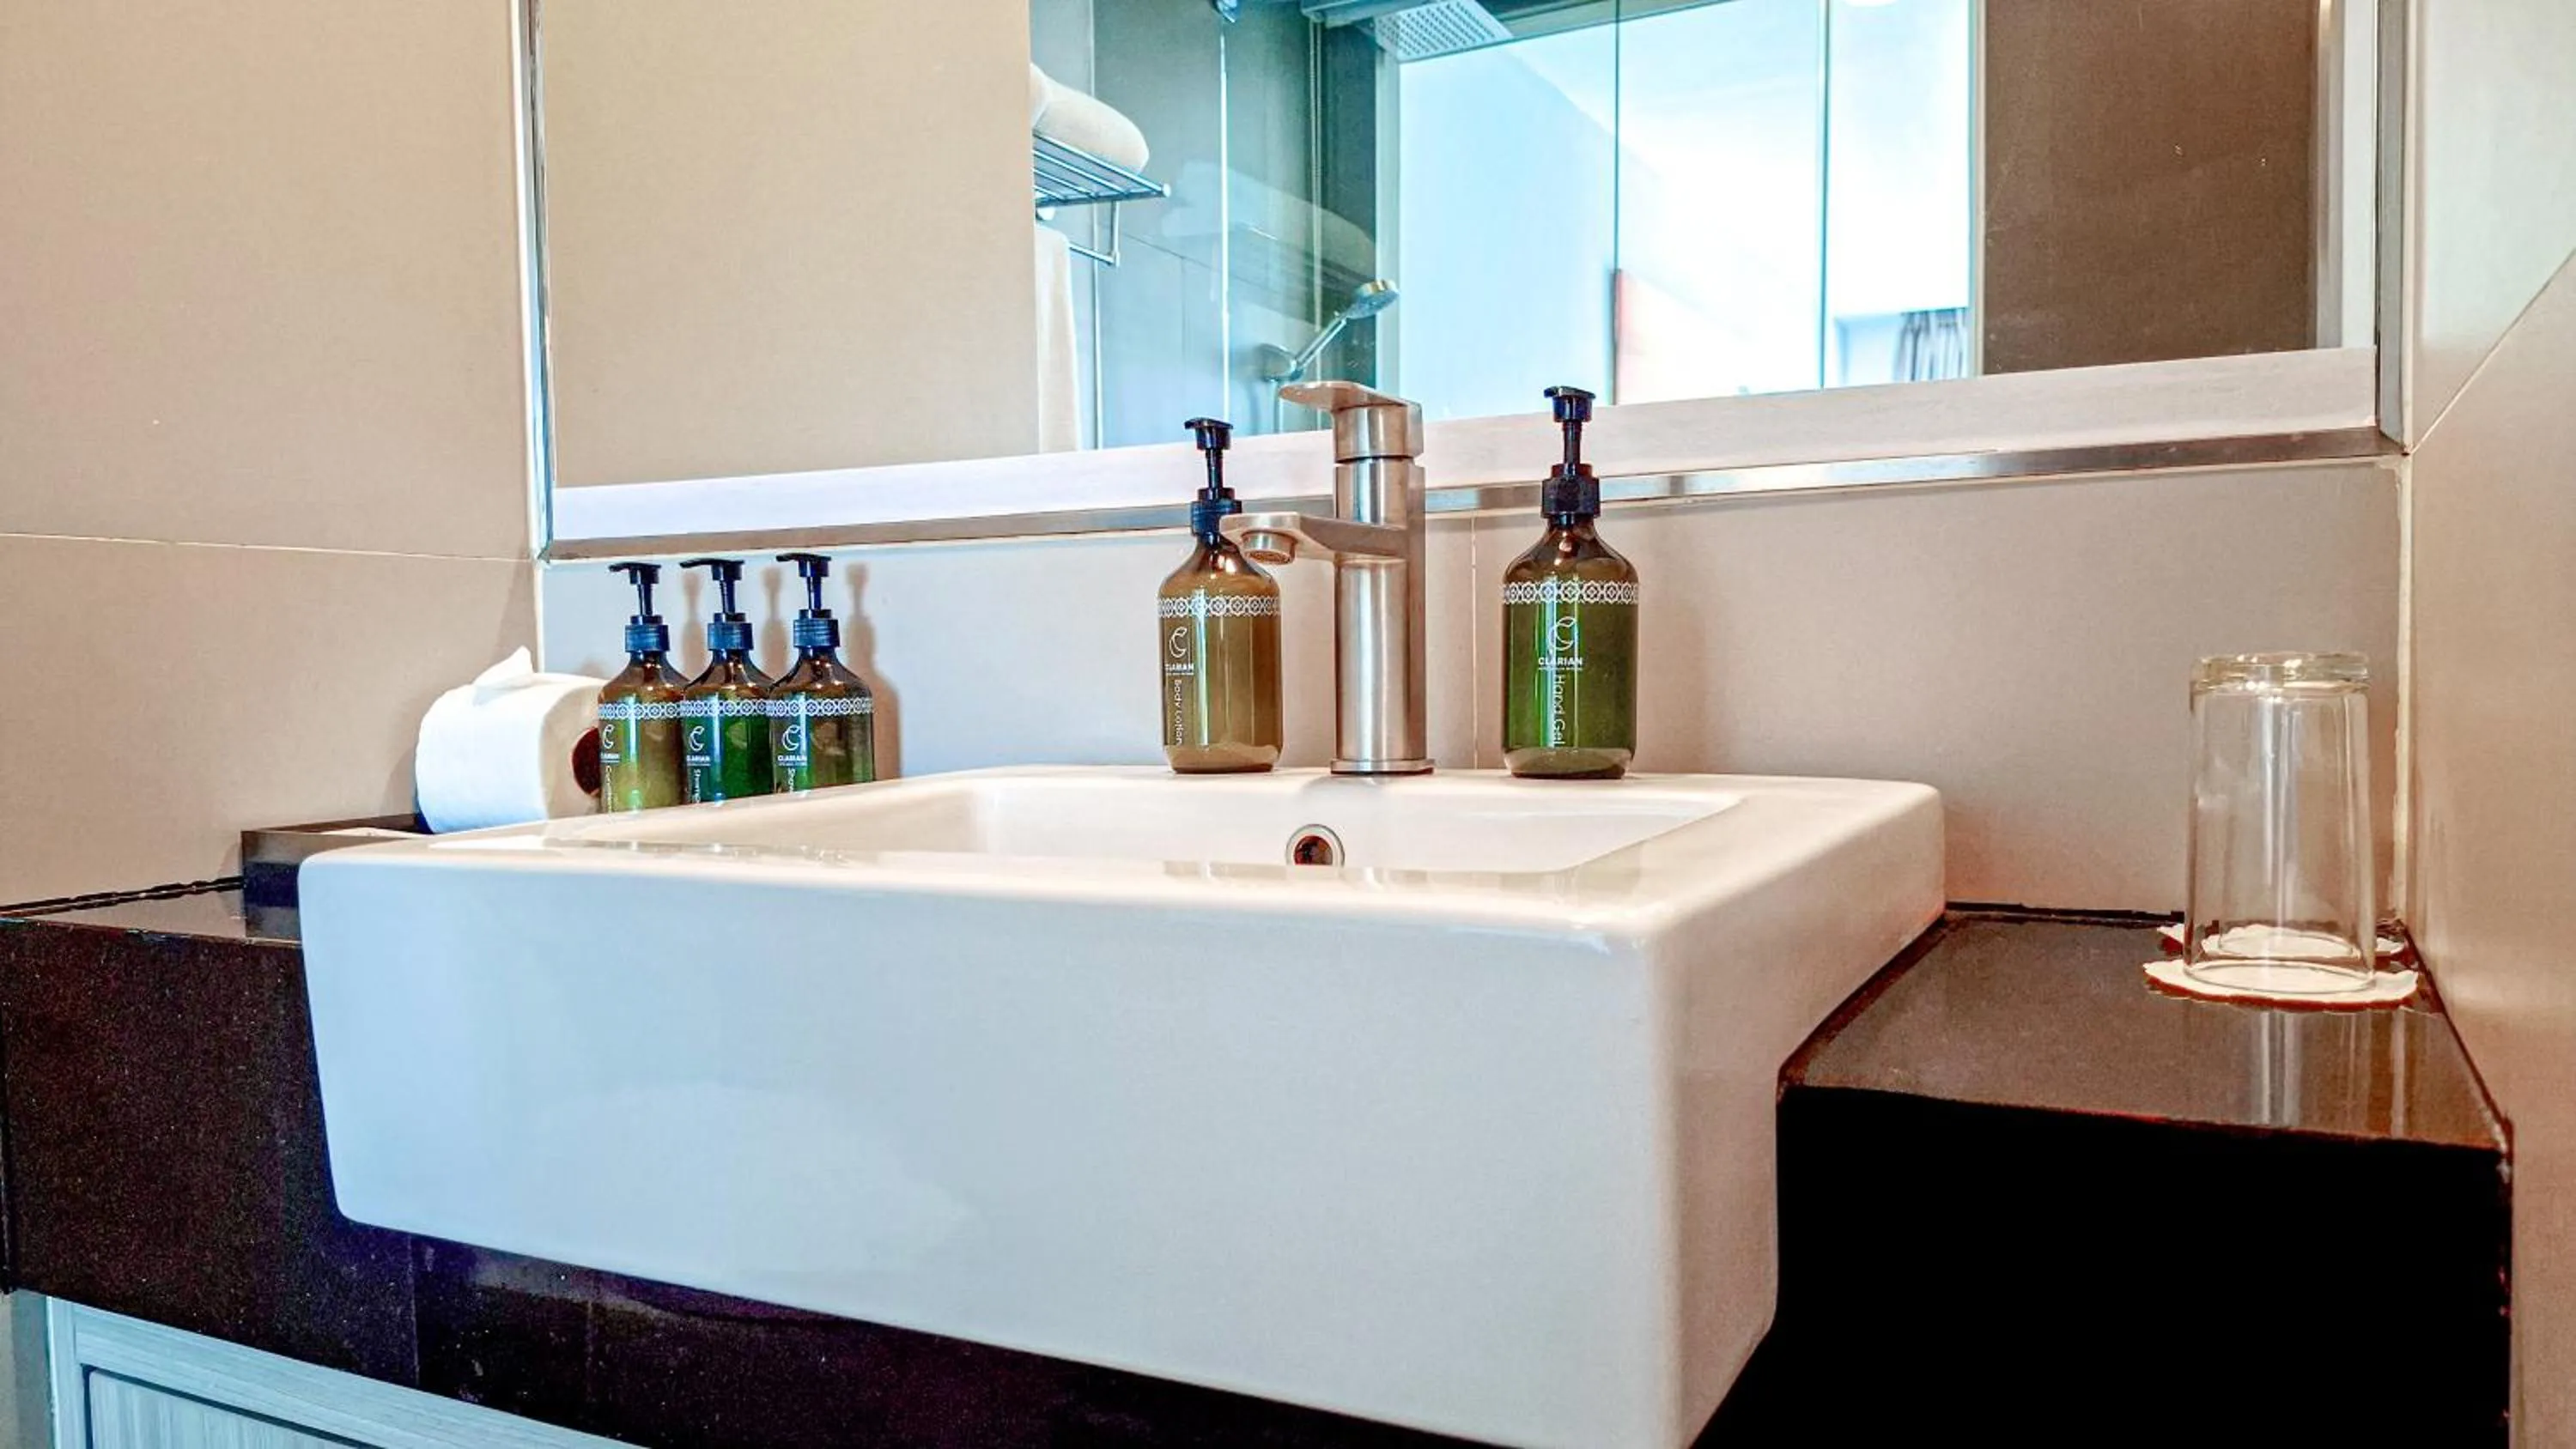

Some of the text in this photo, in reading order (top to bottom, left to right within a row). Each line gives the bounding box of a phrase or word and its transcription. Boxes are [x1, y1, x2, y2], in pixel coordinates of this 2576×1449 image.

[1538, 657, 1583, 665] CLARIAN
[1173, 679, 1184, 745] Body Lotion
[1553, 674, 1566, 745] Hand Gel
